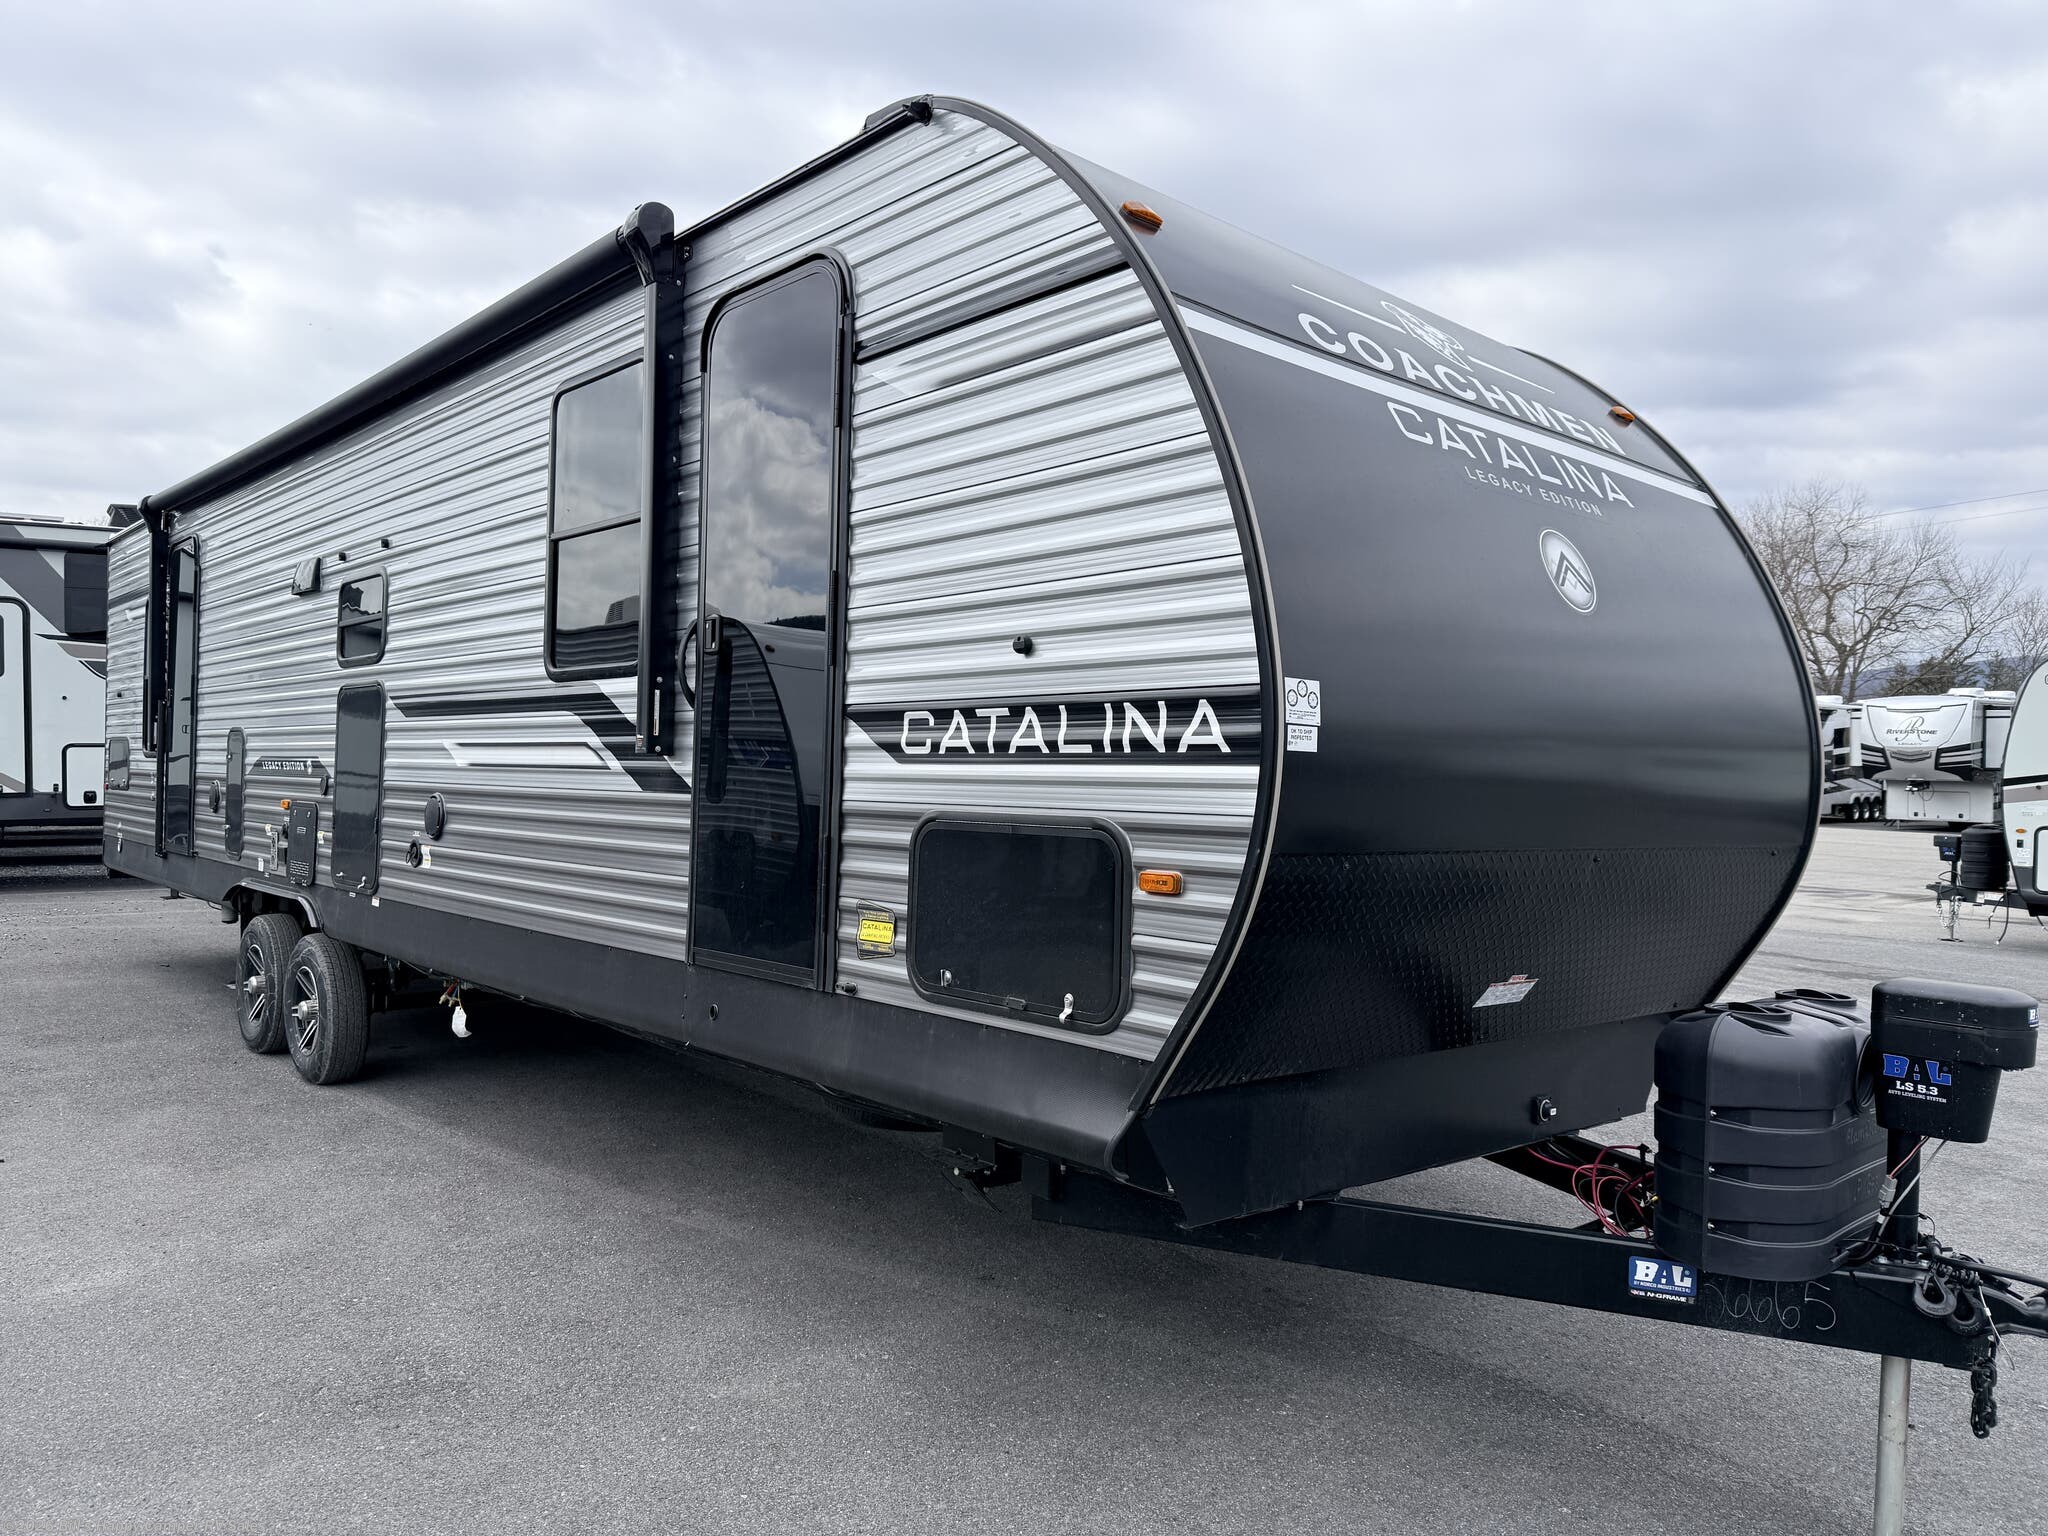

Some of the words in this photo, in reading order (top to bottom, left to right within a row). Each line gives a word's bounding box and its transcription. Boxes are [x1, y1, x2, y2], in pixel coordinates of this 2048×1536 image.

[1298, 313, 1627, 455] COACHMEN
[1386, 401, 1635, 508] CATALINA
[1464, 466, 1533, 496] LEGACY
[1538, 487, 1603, 517] EDITION
[900, 698, 1231, 755] CATALINA
[261, 761, 282, 770] LEGACY
[282, 761, 305, 771] EDITION
[863, 922, 893, 932] CATALINA
[1882, 1053, 1952, 1086] BAL
[1895, 1080, 1914, 1092] LS
[1901, 1091, 1926, 1100] LEVELING
[1926, 1096, 1947, 1104] SYSTEM
[1634, 1260, 1692, 1288] BAL
